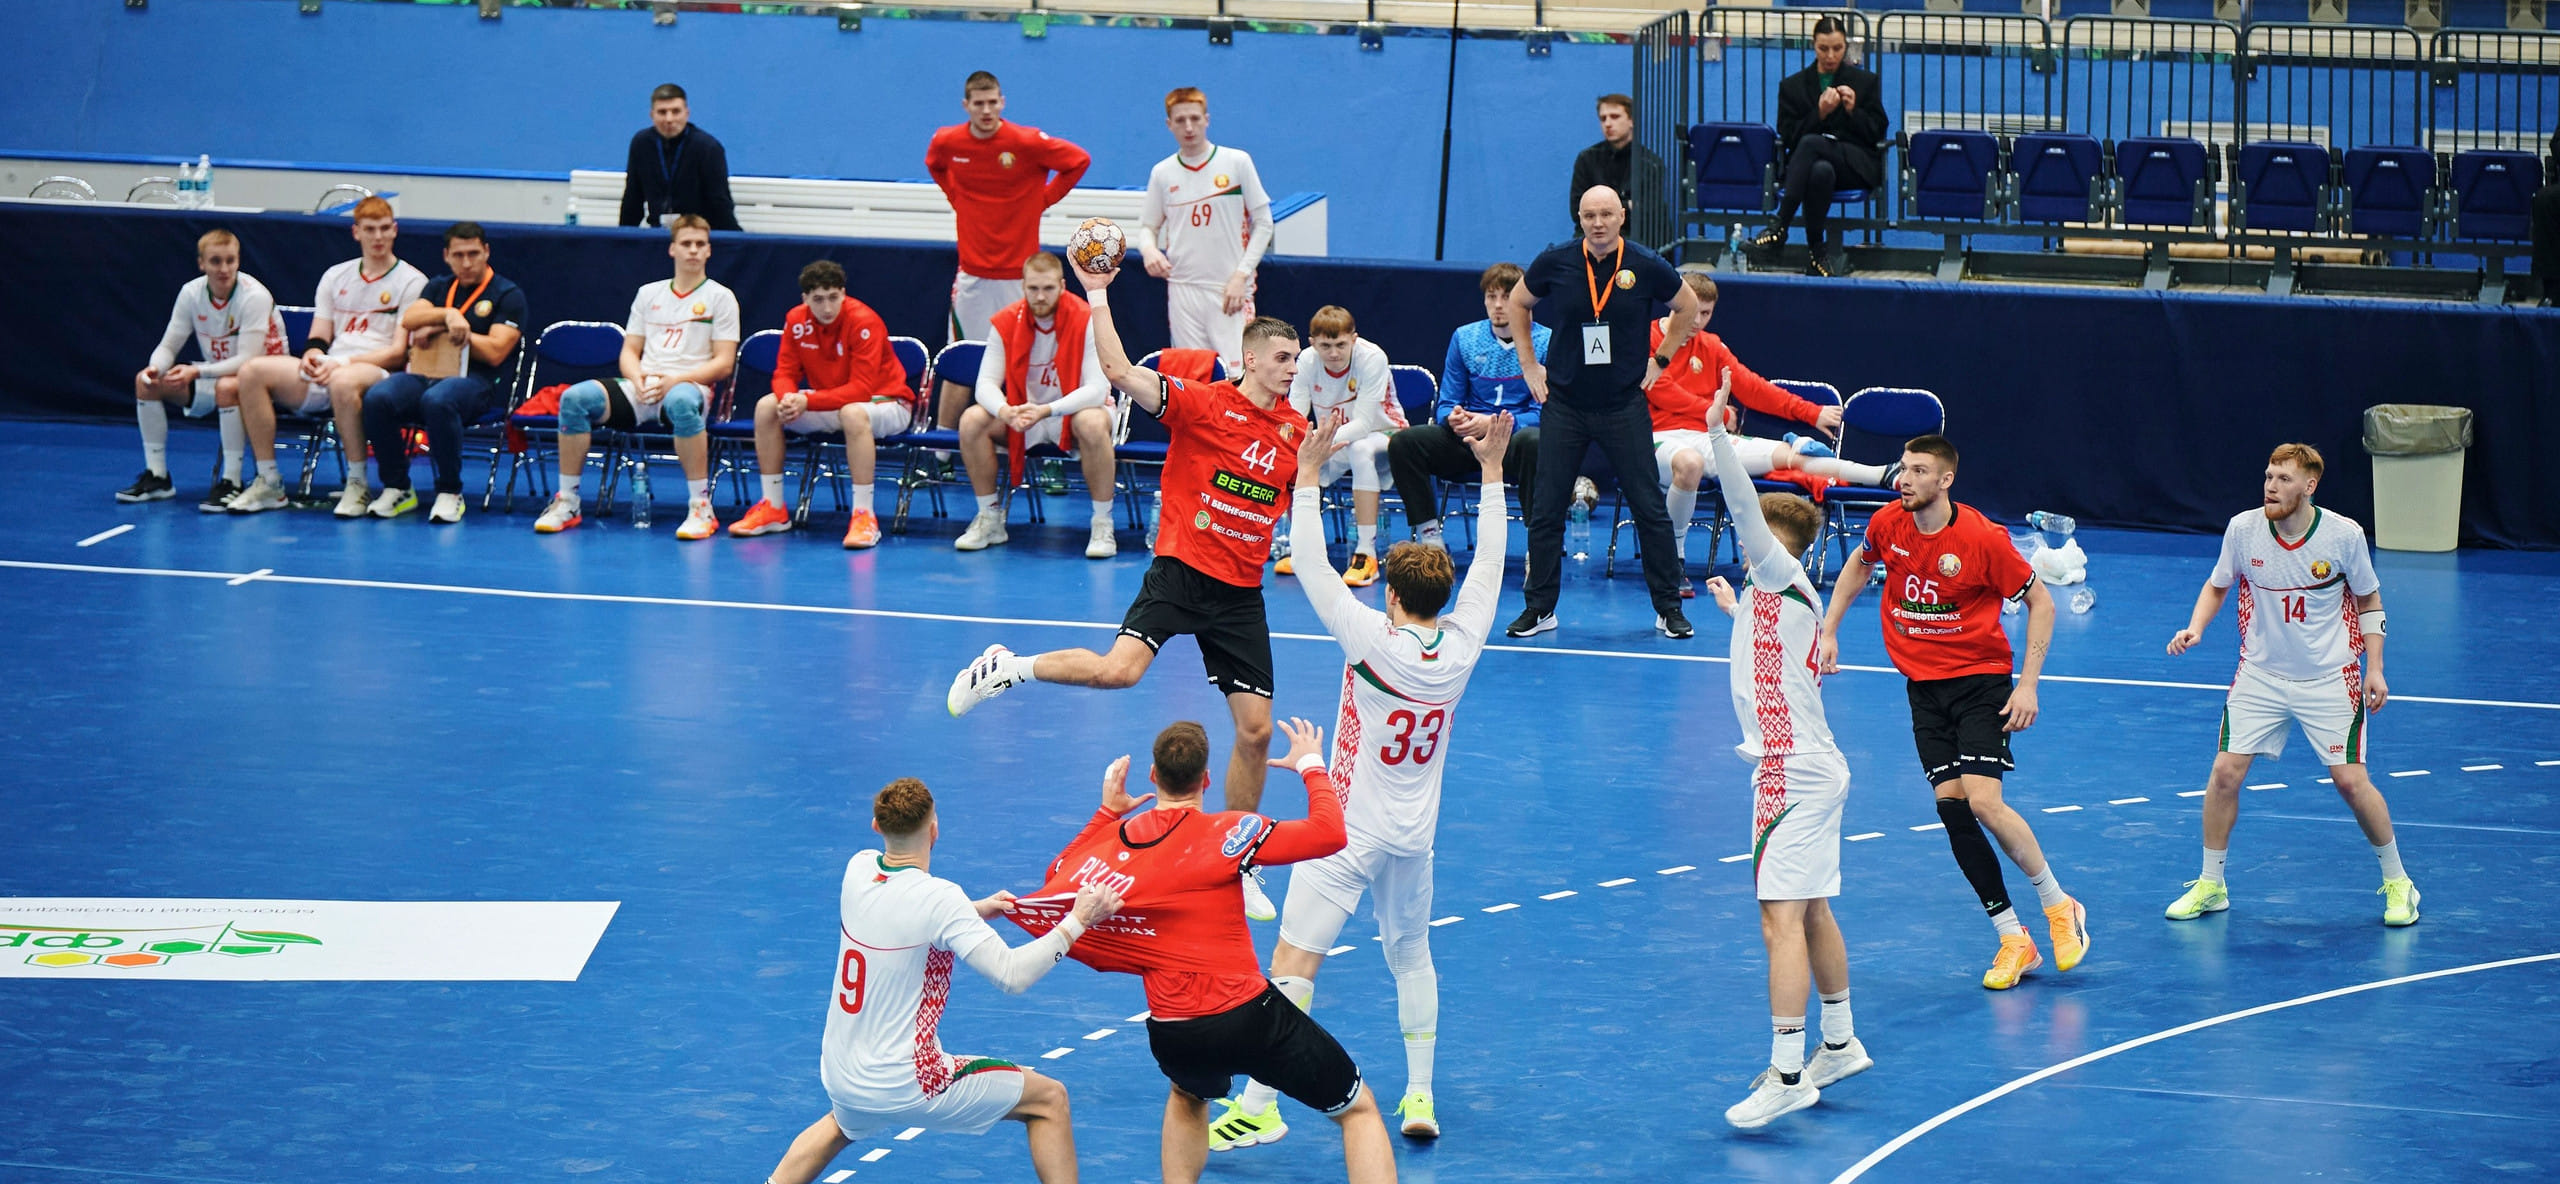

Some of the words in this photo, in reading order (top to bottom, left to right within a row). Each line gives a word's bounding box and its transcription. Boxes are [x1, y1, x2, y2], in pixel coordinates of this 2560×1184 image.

[1191, 203, 1212, 227] 69
[344, 316, 369, 333] 44
[792, 320, 814, 339] 95
[664, 328, 683, 348] 77
[1590, 337, 1605, 354] A
[210, 340, 230, 360] 55
[1494, 384, 1504, 406] 1
[1225, 409, 1248, 422] Kempa
[1240, 440, 1277, 475] 44
[1211, 498, 1274, 525] БЕЛНЕФТЕСТРАХ
[1890, 543, 1910, 557] Kempa
[1905, 574, 1939, 605] 65
[2281, 594, 2307, 623] 14
[1380, 709, 1445, 765] 33
[840, 949, 866, 1015] 9
